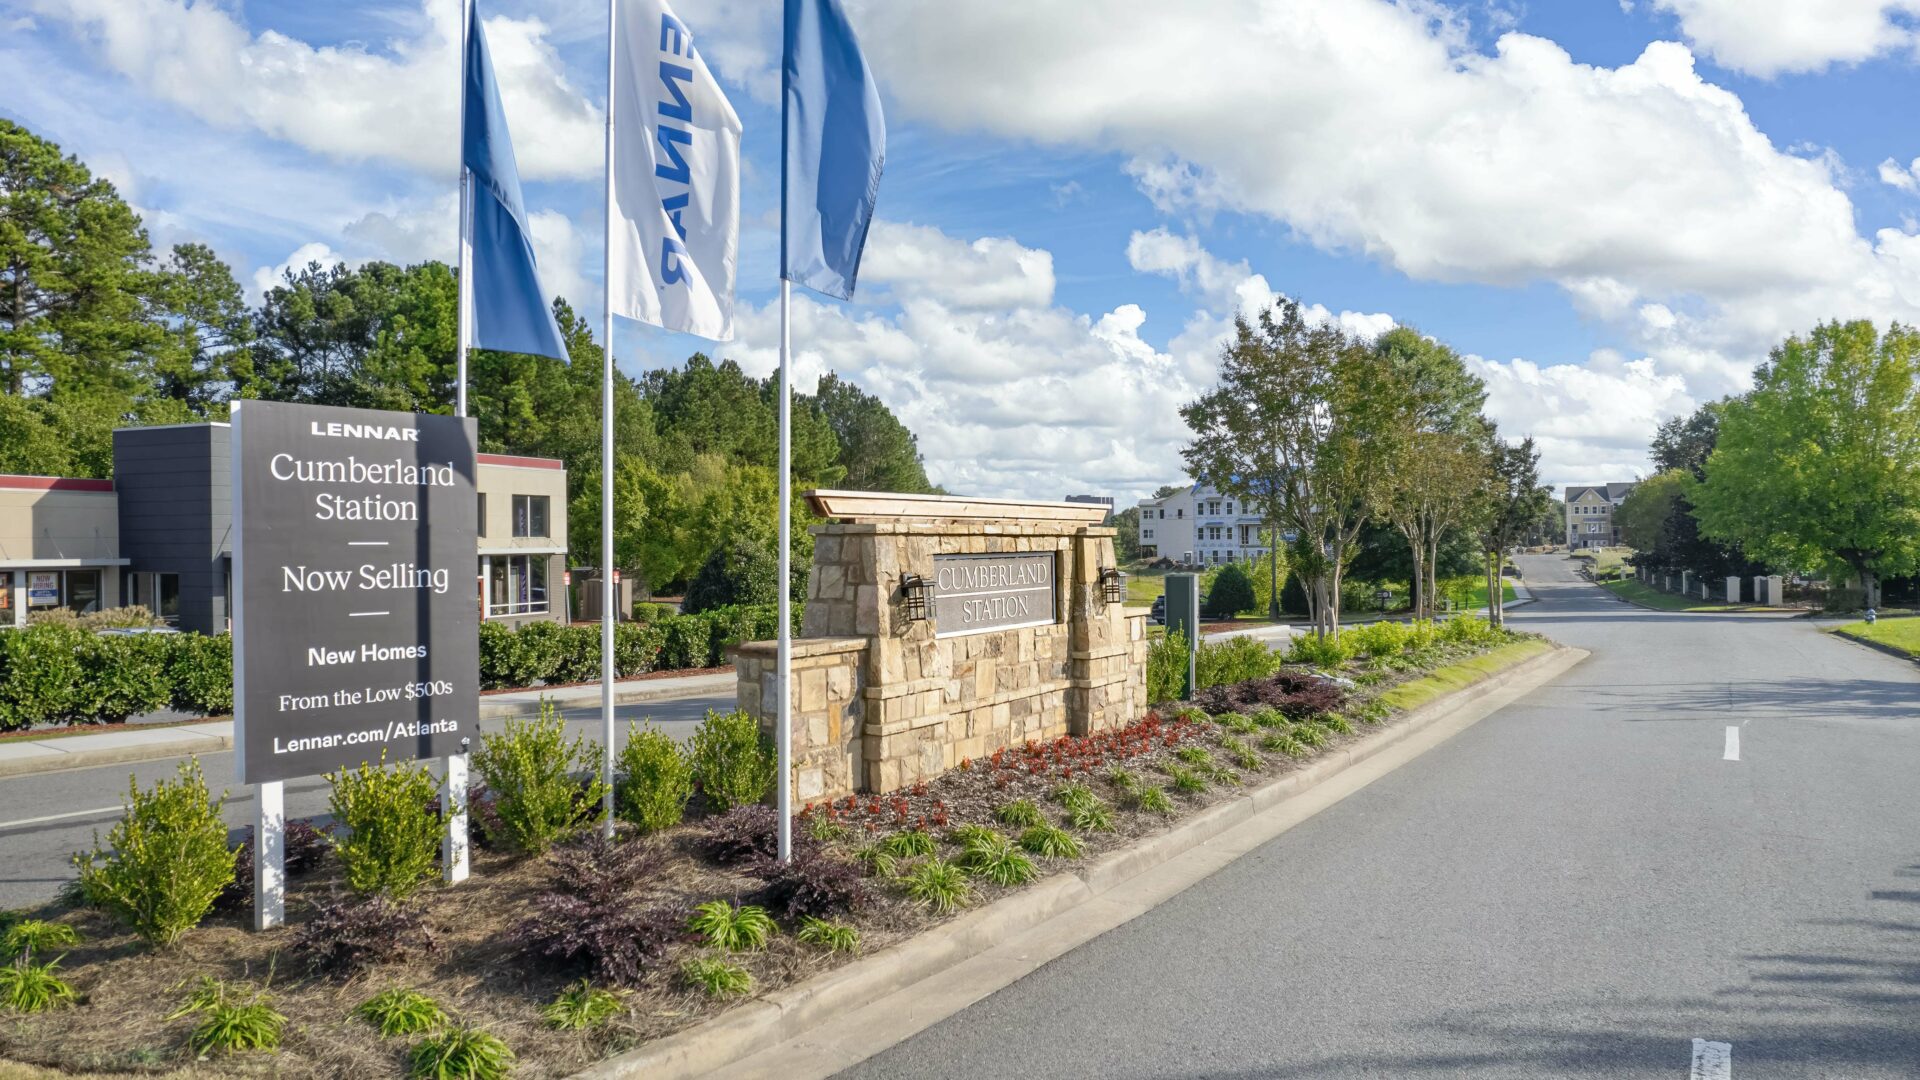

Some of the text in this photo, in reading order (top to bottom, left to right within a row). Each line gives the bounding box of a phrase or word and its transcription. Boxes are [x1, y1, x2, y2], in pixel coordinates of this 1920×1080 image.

[311, 421, 418, 442] LENNAR
[270, 453, 455, 487] Cumberland
[315, 493, 418, 521] Station
[282, 563, 449, 594] Now Selling
[938, 563, 1047, 590] CUMBERLAND
[963, 595, 1029, 623] STATION
[308, 643, 427, 666] New Homes
[279, 680, 453, 712] From the Low $500s
[274, 718, 458, 754] Lennar.com/Atlanta
